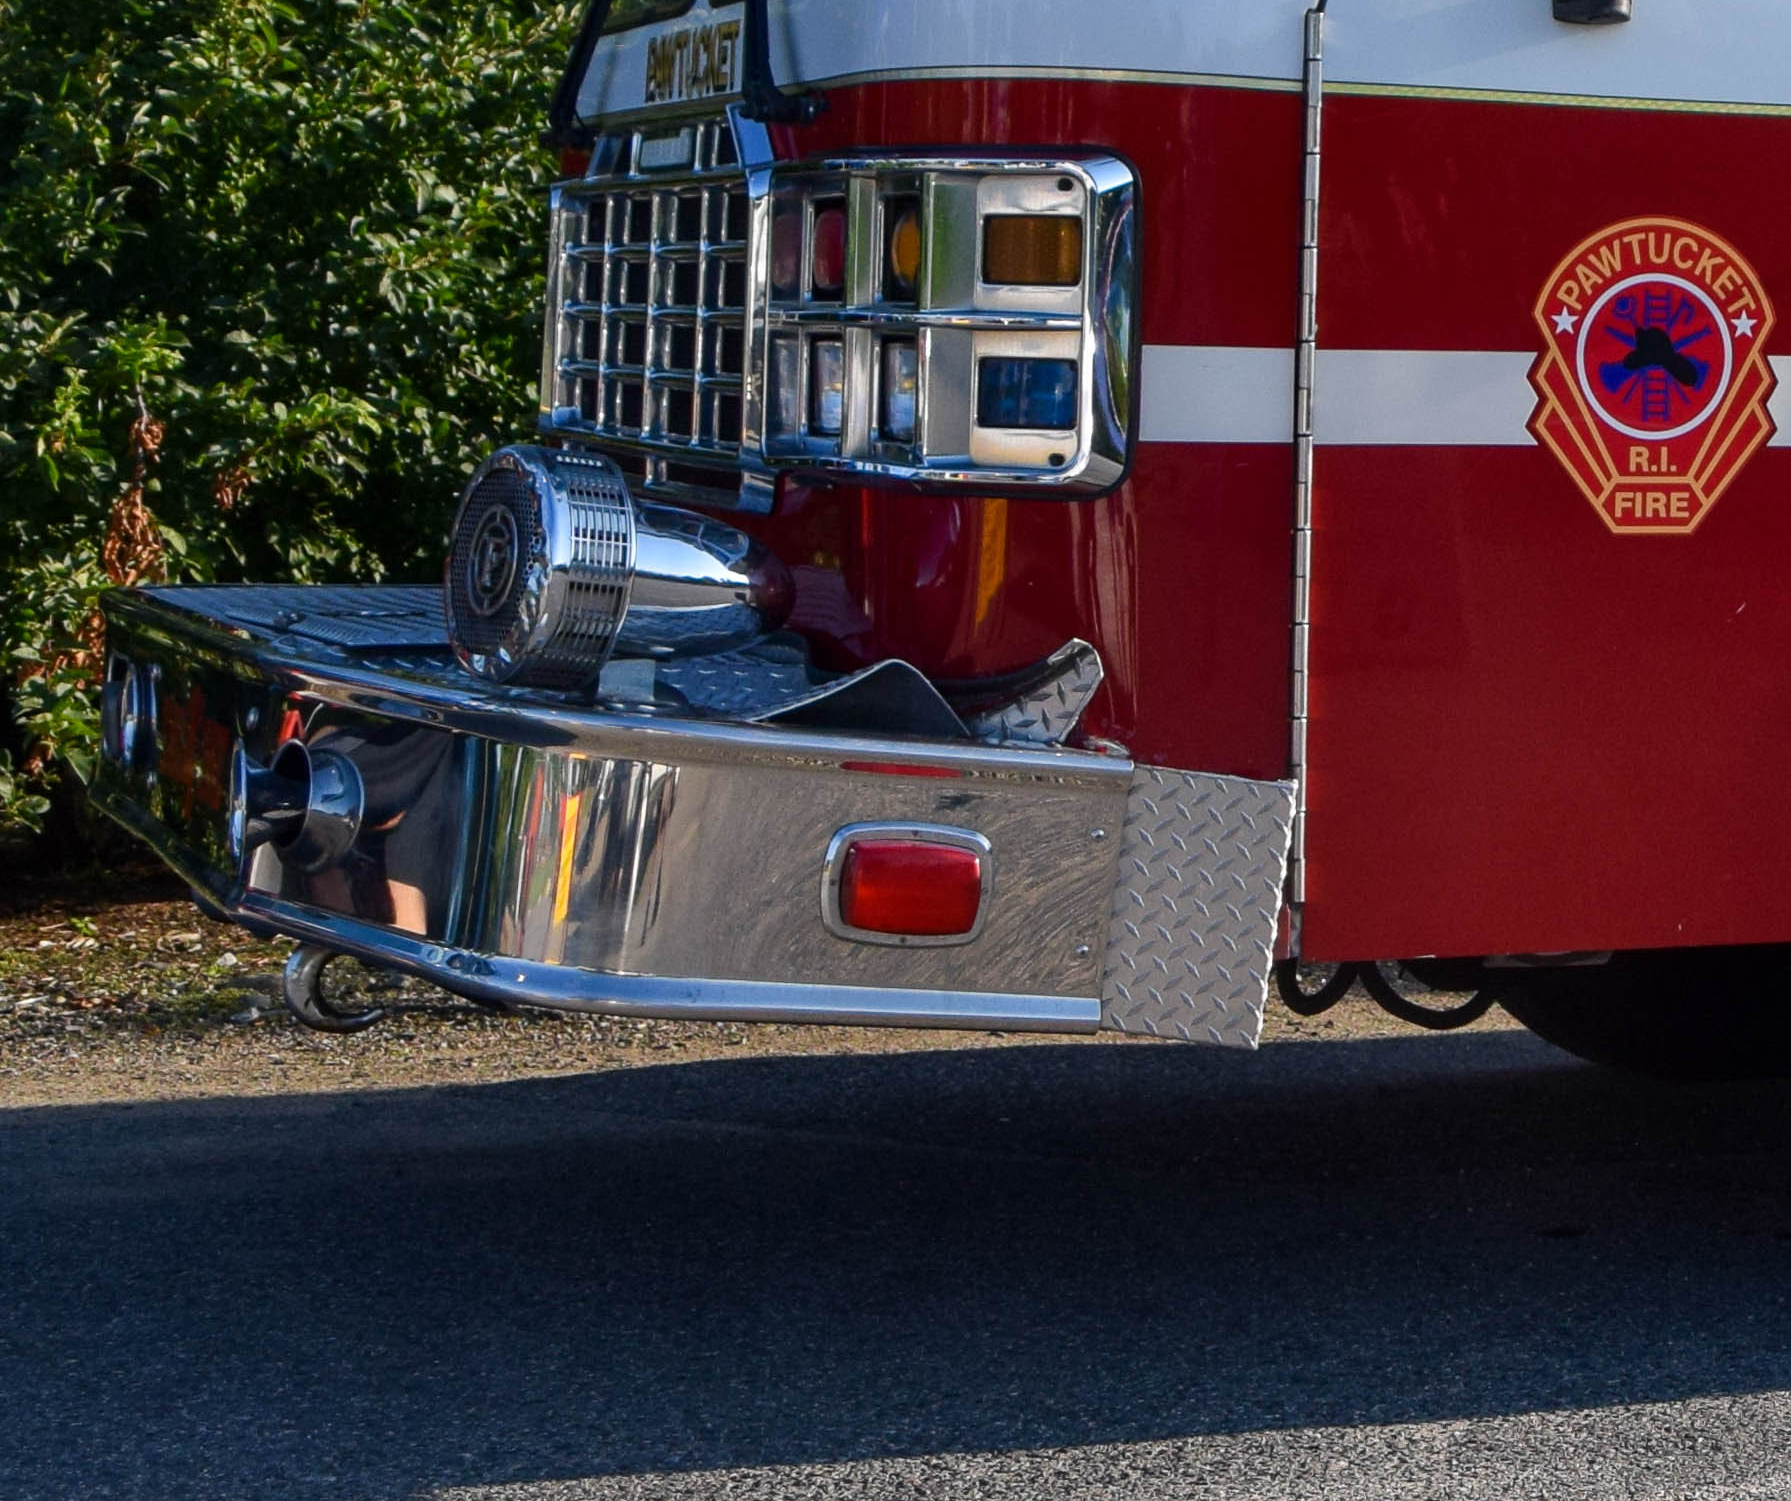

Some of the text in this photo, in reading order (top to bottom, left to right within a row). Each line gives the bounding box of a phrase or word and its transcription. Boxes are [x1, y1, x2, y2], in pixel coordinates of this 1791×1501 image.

[1555, 231, 1758, 315] PAWTUCKET
[1628, 445, 1678, 473] R.I.
[1613, 491, 1691, 519] FIRE
